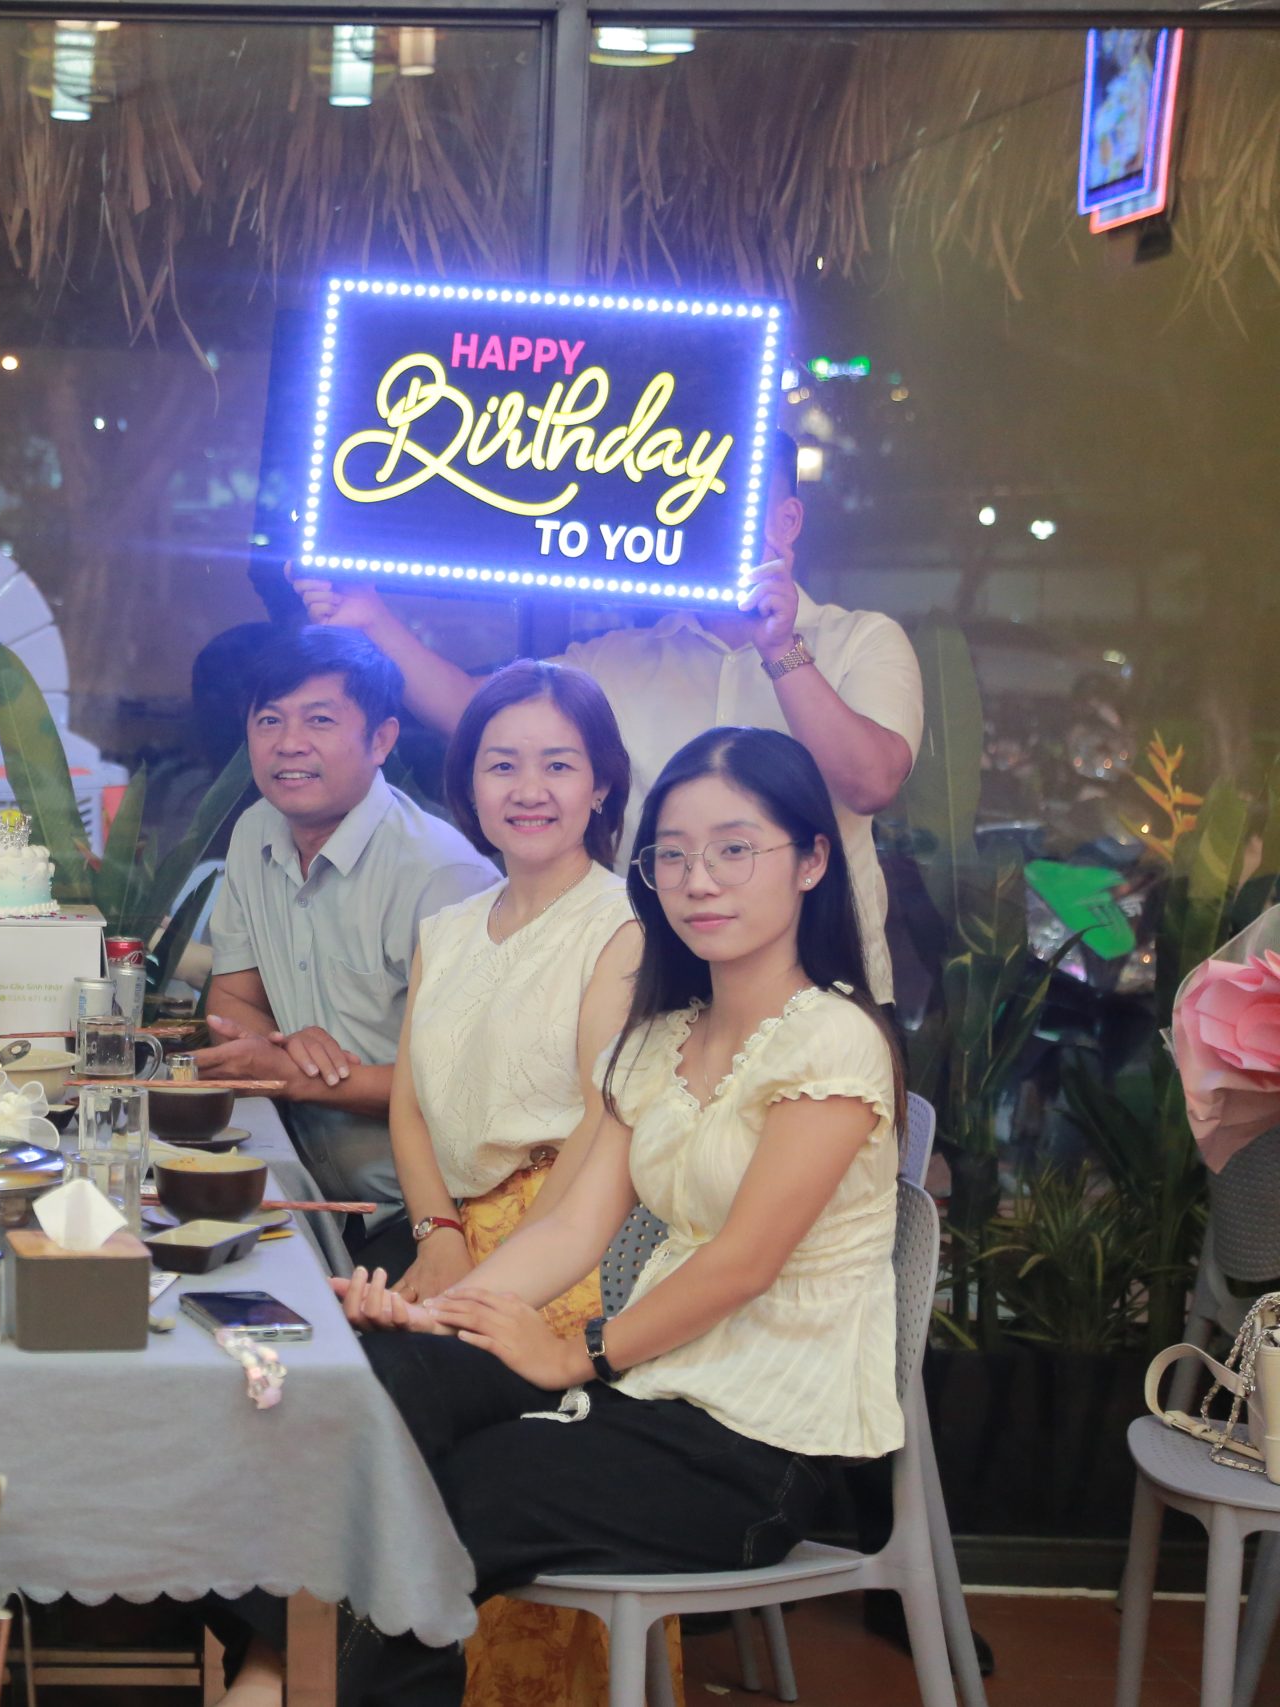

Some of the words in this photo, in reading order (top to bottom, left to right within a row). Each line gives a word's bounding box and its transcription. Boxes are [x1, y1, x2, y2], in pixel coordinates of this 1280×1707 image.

[451, 333, 586, 375] HAPPY
[333, 353, 733, 525] Birthday
[534, 519, 589, 558] TO
[599, 525, 683, 566] YOU
